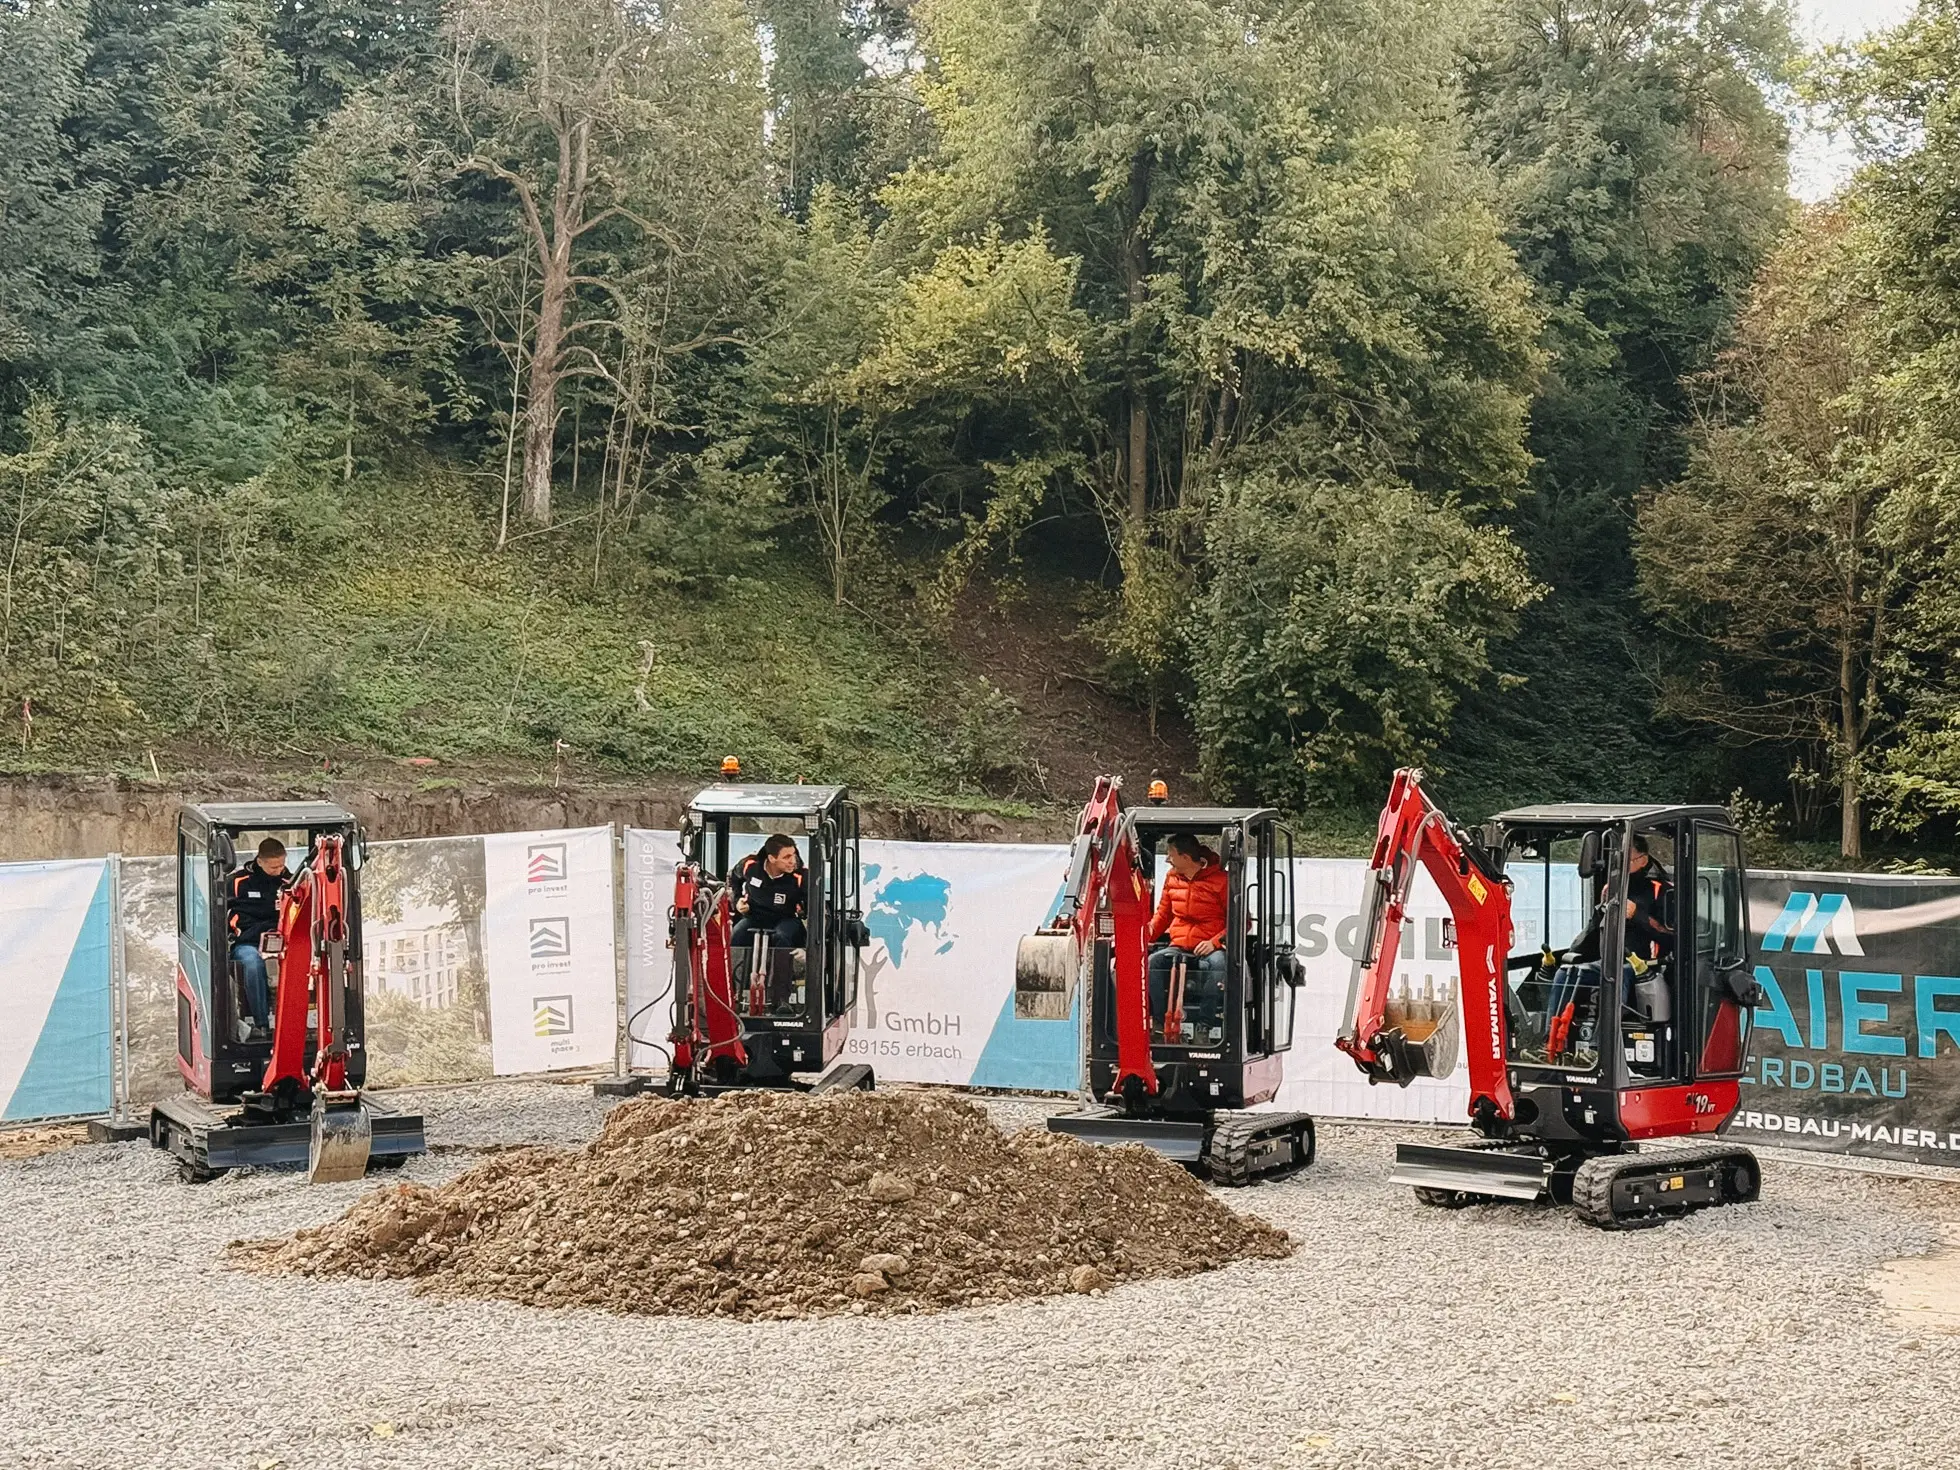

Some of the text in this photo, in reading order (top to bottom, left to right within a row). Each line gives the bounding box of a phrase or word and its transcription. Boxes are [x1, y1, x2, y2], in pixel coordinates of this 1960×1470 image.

[528, 885, 567, 895] pro invest
[640, 843, 654, 967] www.resoil.de
[532, 961, 571, 971] pro invest
[1488, 976, 1501, 1060] YANMAR
[1738, 965, 1960, 1060] AIER
[885, 1012, 961, 1036] GmbH
[849, 1038, 962, 1059] 89155 erbach
[1188, 1052, 1221, 1060] YANMAR
[1566, 1075, 1598, 1085] YANMAR
